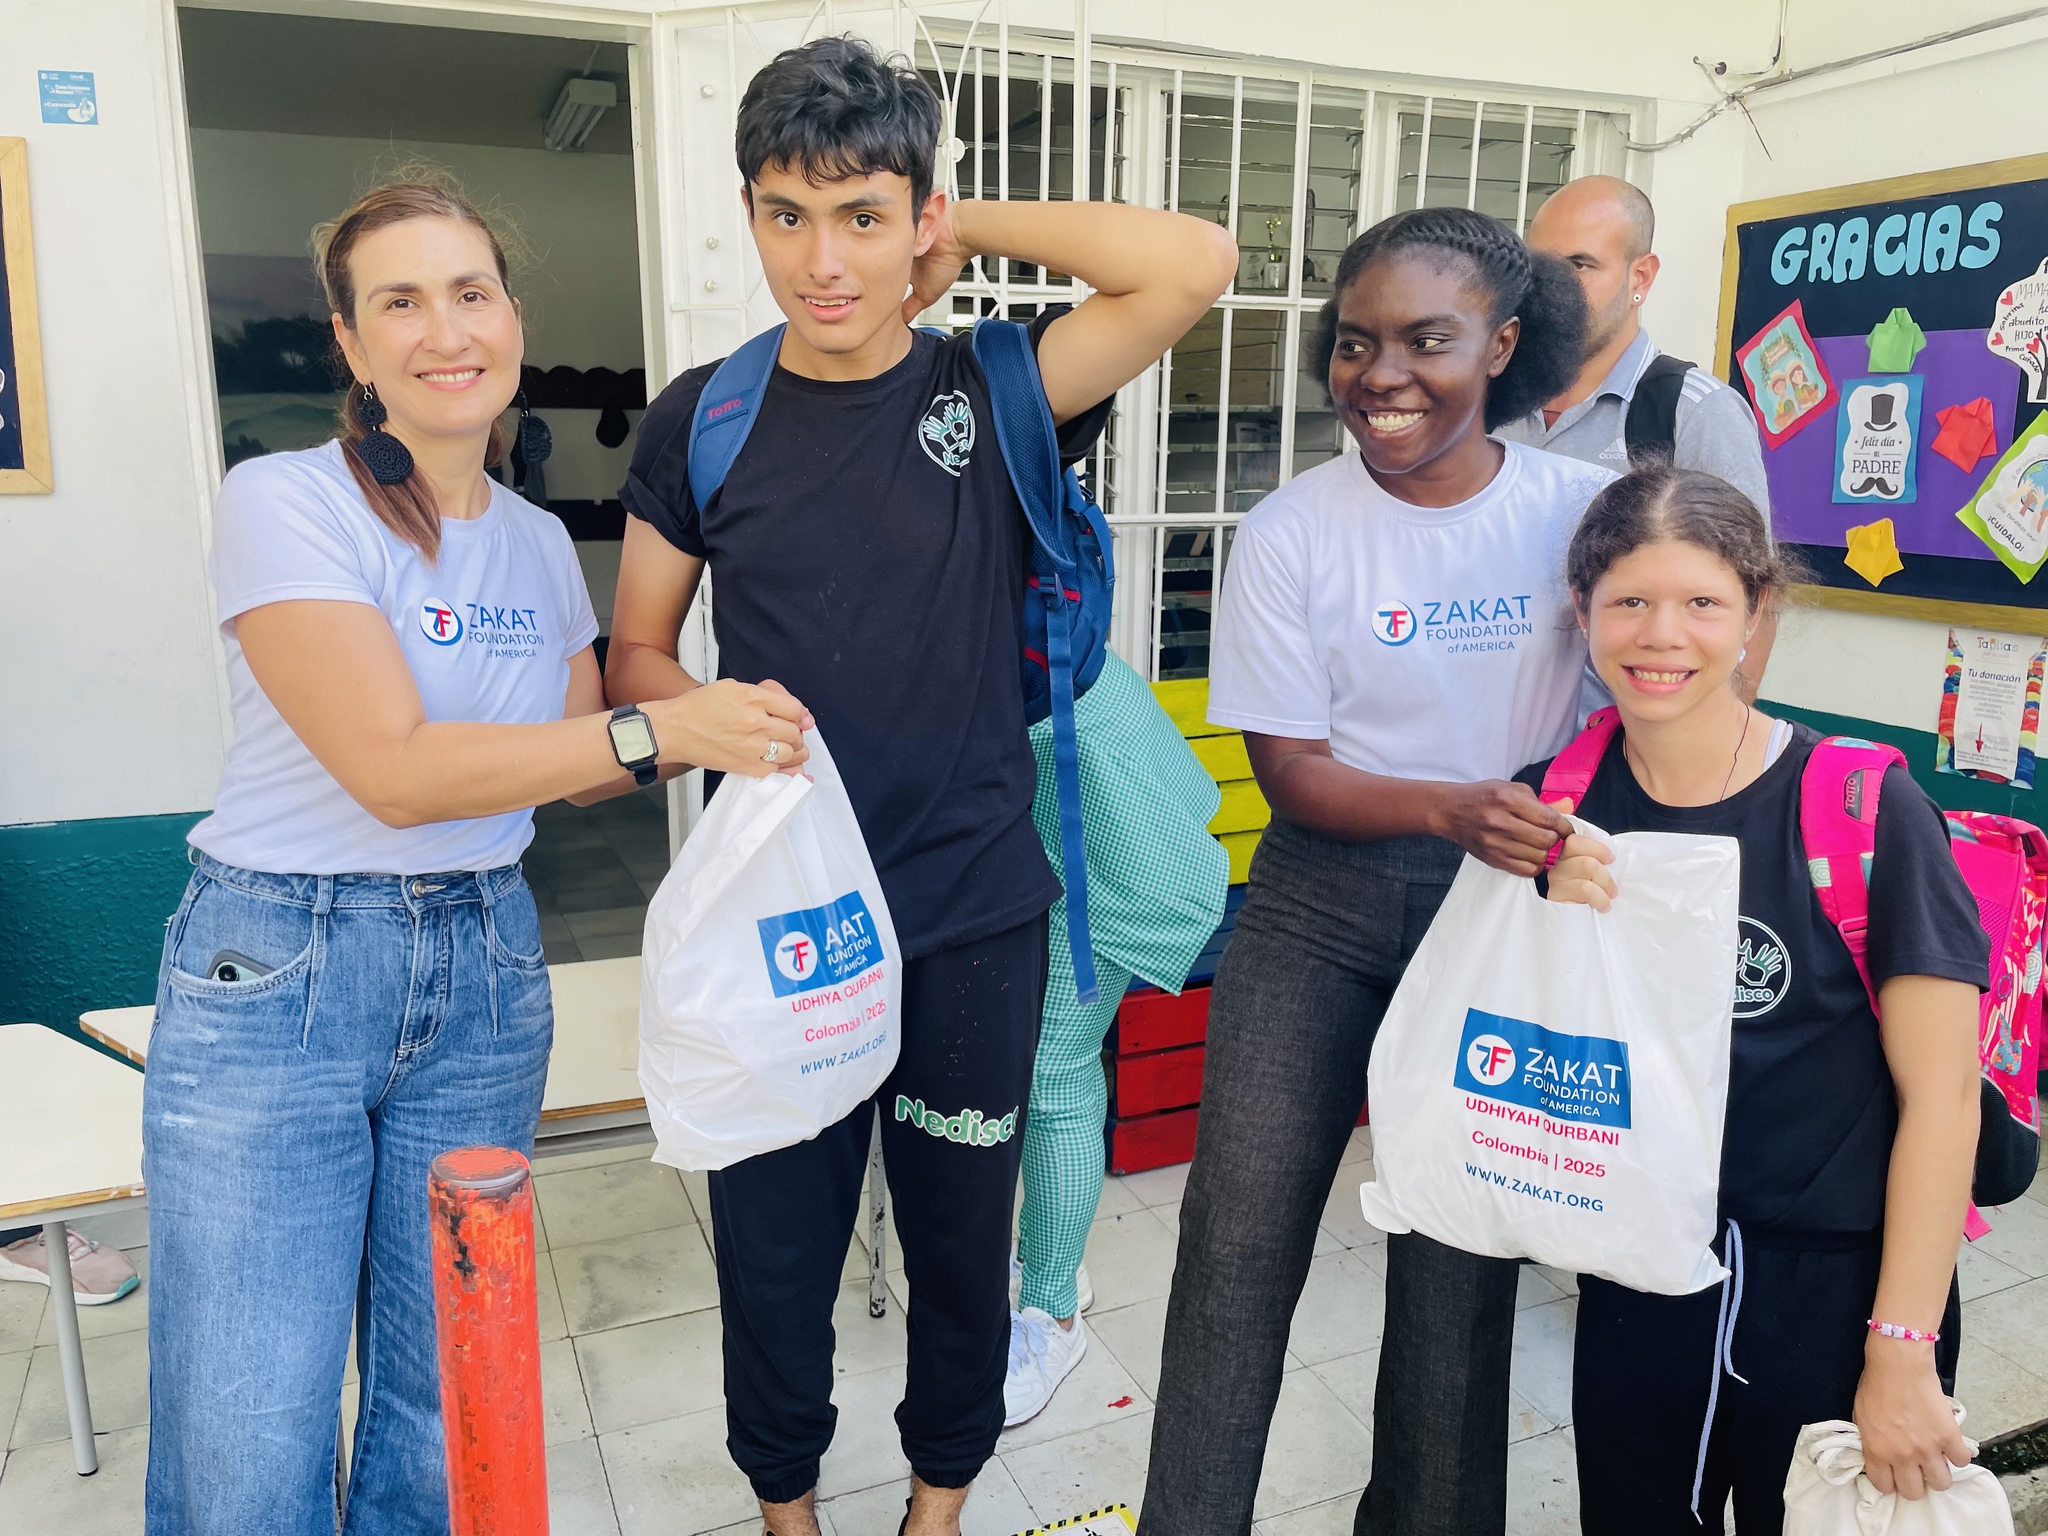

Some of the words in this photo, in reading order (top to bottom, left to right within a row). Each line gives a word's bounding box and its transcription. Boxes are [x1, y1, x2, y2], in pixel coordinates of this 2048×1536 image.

[1771, 202, 2004, 285] GRACIAS
[706, 398, 742, 420] TOTTO
[1852, 459, 1902, 474] PADRE
[466, 603, 537, 631] ZAKAT
[1423, 595, 1531, 626] ZAKAT
[469, 631, 545, 646] FOUNDATION
[1426, 623, 1532, 641] FOUNDATION
[495, 649, 537, 659] AMERICA
[1447, 644, 1459, 653] of
[1462, 641, 1515, 653] AMERICA
[1968, 668, 1978, 678] Tu
[1845, 777, 1856, 810] TOTTO
[1524, 1048, 1622, 1089] ZAKAT
[1523, 1074, 1620, 1105] FOUNDATION
[1540, 1096, 1549, 1105] of
[1549, 1099, 1601, 1117] AMERICA
[1465, 1097, 1540, 1127] UDHIYAH
[1543, 1119, 1620, 1146] QURBANI
[1472, 1131, 1549, 1165] Colombia
[1563, 1157, 1606, 1178] 2025
[1465, 1162, 1604, 1212] WWW.ZAKAT.ORG
